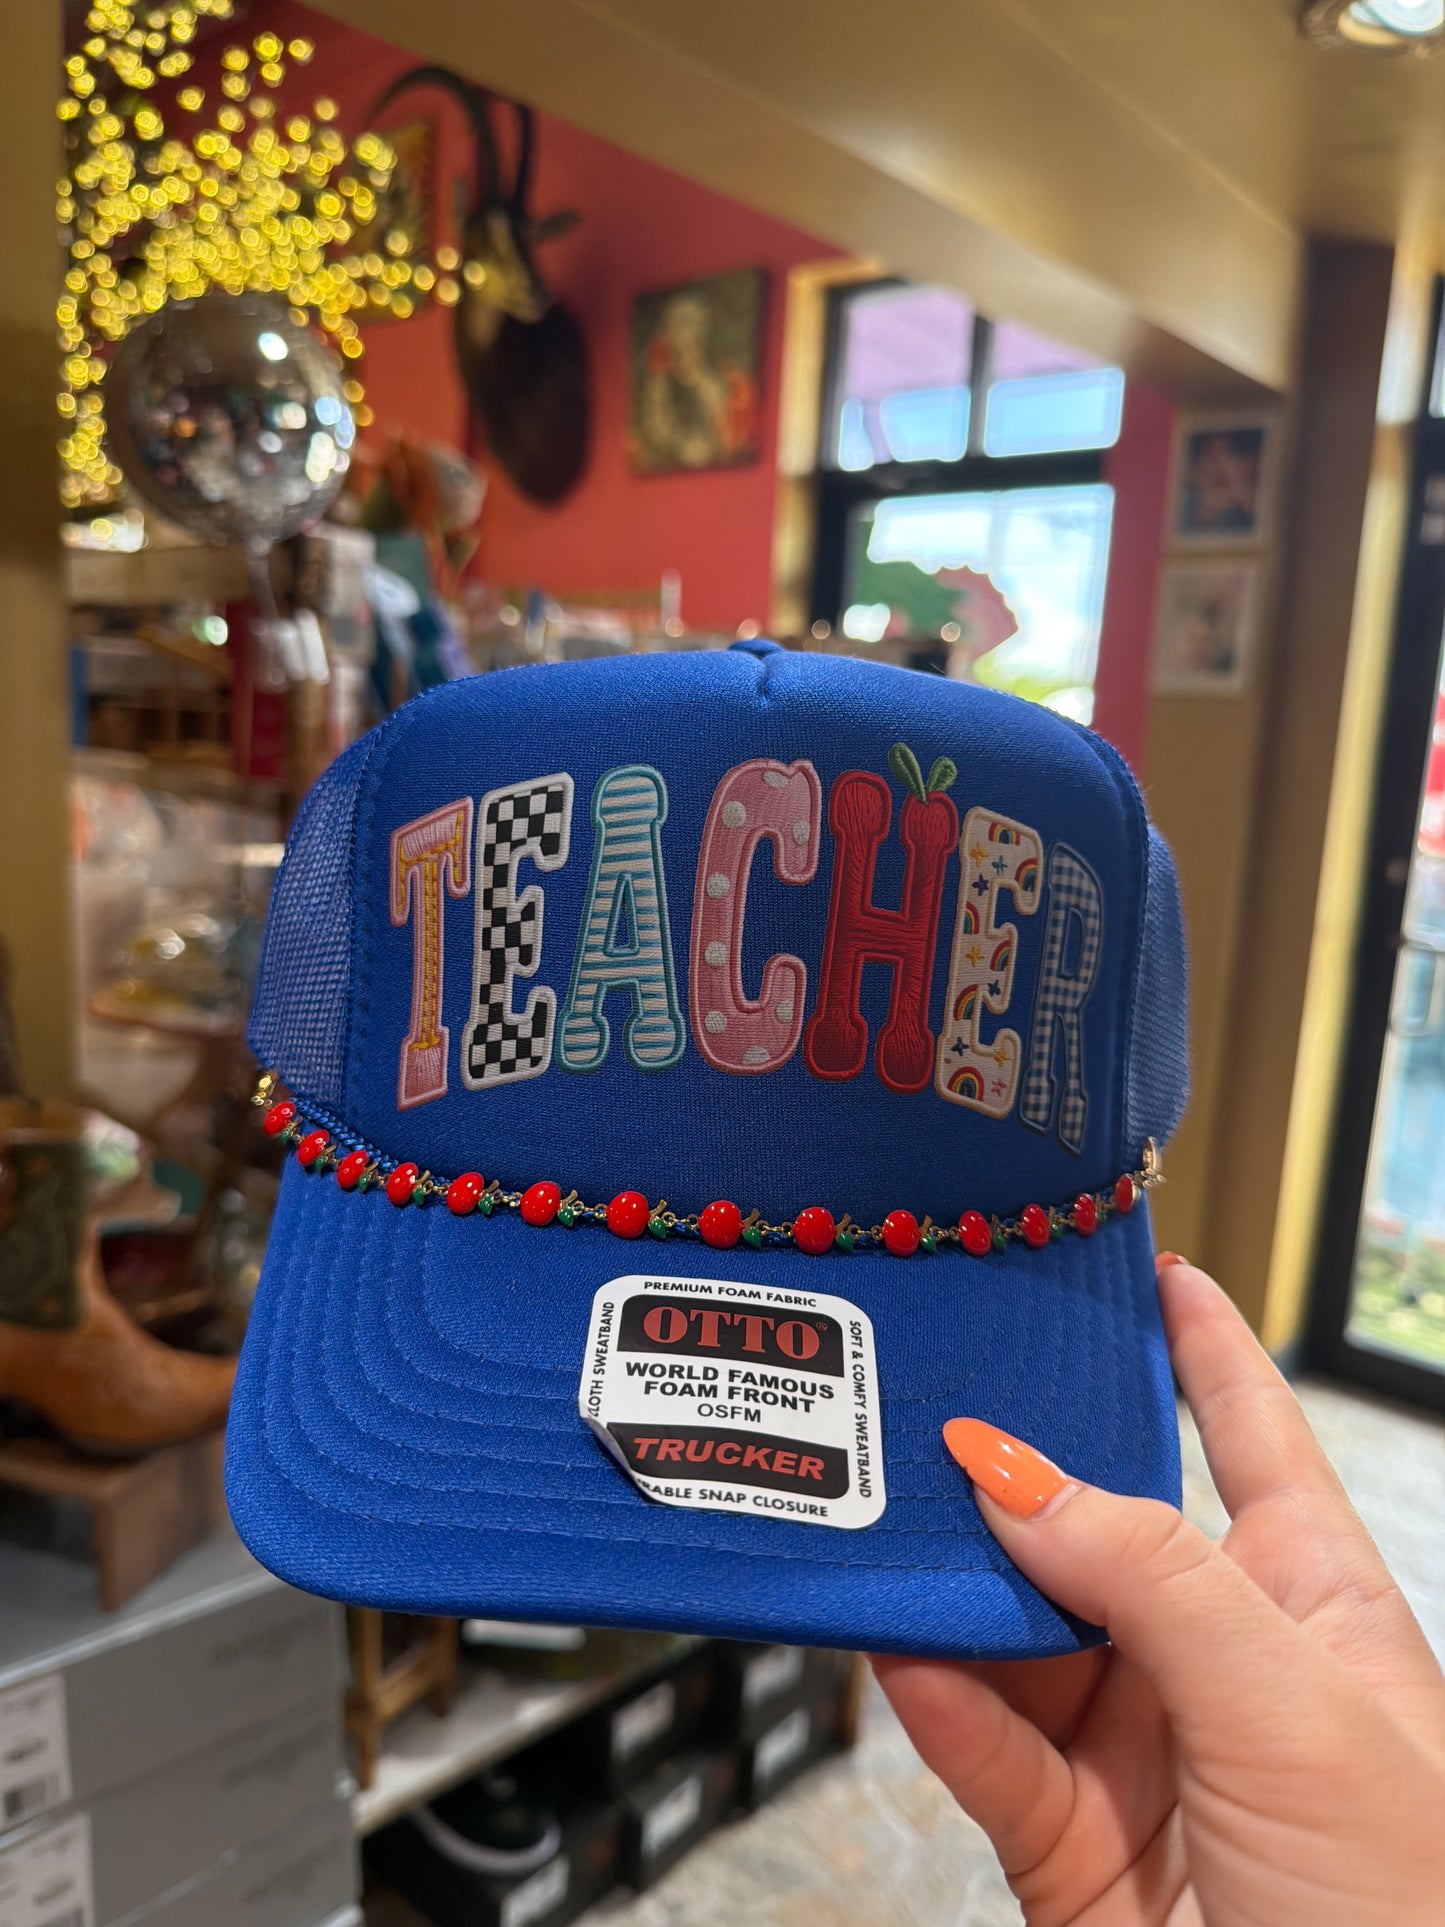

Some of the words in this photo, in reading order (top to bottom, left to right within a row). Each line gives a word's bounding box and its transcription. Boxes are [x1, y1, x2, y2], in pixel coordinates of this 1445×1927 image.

[390, 755, 1105, 1158] TEACHER
[644, 1281, 713, 1294] PREMIUM
[718, 1286, 762, 1300] FOAM
[766, 1292, 817, 1307] FABRIC
[593, 1301, 615, 1375] SWEATBAND
[849, 1320, 863, 1348] SOFT
[851, 1350, 864, 1359] &
[626, 1362, 719, 1381] WORLD
[728, 1369, 835, 1399] FAMOUS
[644, 1381, 718, 1398] FOAM
[727, 1386, 816, 1413] FRONT
[852, 1363, 868, 1410] COMFY
[697, 1403, 761, 1423] OSFM
[633, 1437, 825, 1480] TRUCKER
[855, 1413, 873, 1498] SWEATBAND
[698, 1488, 747, 1504] SNAP
[752, 1495, 828, 1517] CLOSURE
